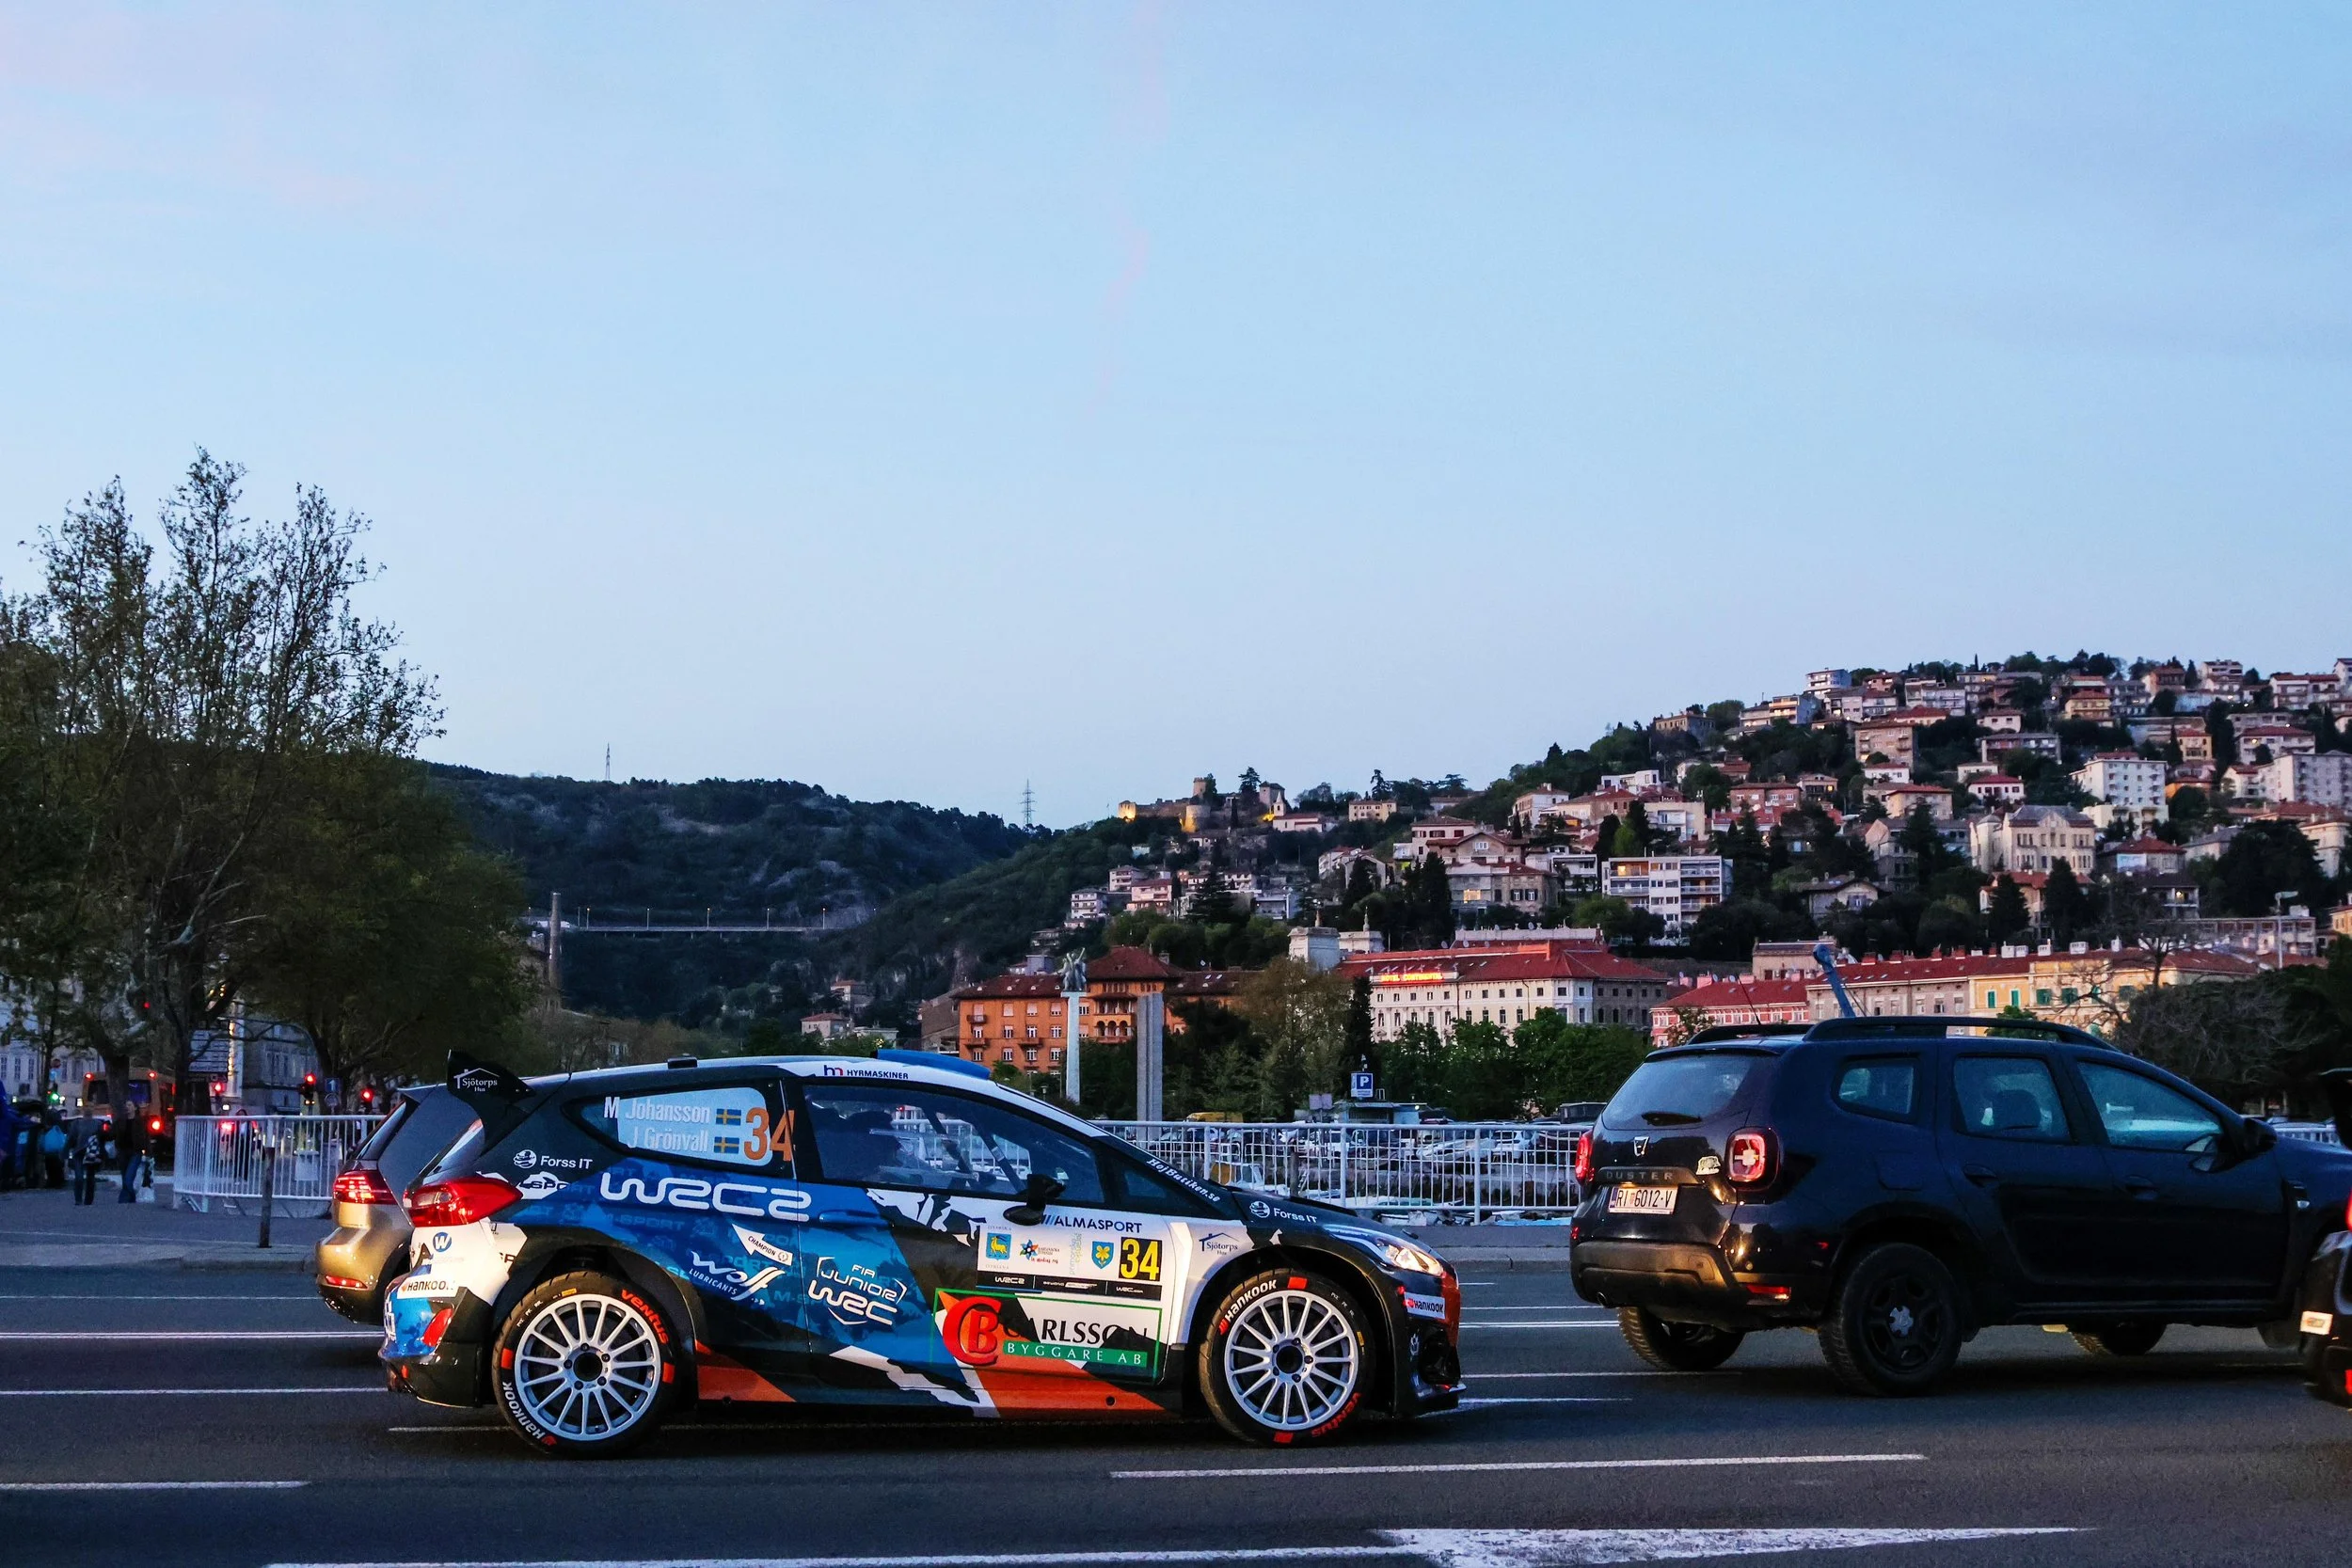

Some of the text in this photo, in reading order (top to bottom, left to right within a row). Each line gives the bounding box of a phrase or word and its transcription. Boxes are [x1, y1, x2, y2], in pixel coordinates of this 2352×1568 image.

[462, 1077, 498, 1087] Sjötorps
[847, 1069, 909, 1080] HYRMASKINER
[1360, 1076, 1370, 1087] P
[604, 1097, 710, 1124] M Johansson
[628, 1127, 708, 1153] J Grönvall
[743, 1107, 795, 1162] 34
[540, 1156, 594, 1170] Forss IT
[1606, 1171, 1674, 1180] DUSTER
[600, 1172, 812, 1222] WRC2
[1616, 1190, 1629, 1207] RI
[1054, 1215, 1142, 1234] ALMASPORT
[1274, 1208, 1317, 1224] Forss IT
[748, 1235, 776, 1257] CHAMPION
[1206, 1241, 1238, 1252] Sjötorps
[1120, 1238, 1159, 1280] 34
[852, 1264, 876, 1278] FIA
[689, 1268, 738, 1295] LUBRICANTS
[820, 1269, 898, 1302] JUNIOR
[808, 1279, 898, 1325] WRC
[1008, 1342, 1141, 1365] BYGGARE AB
